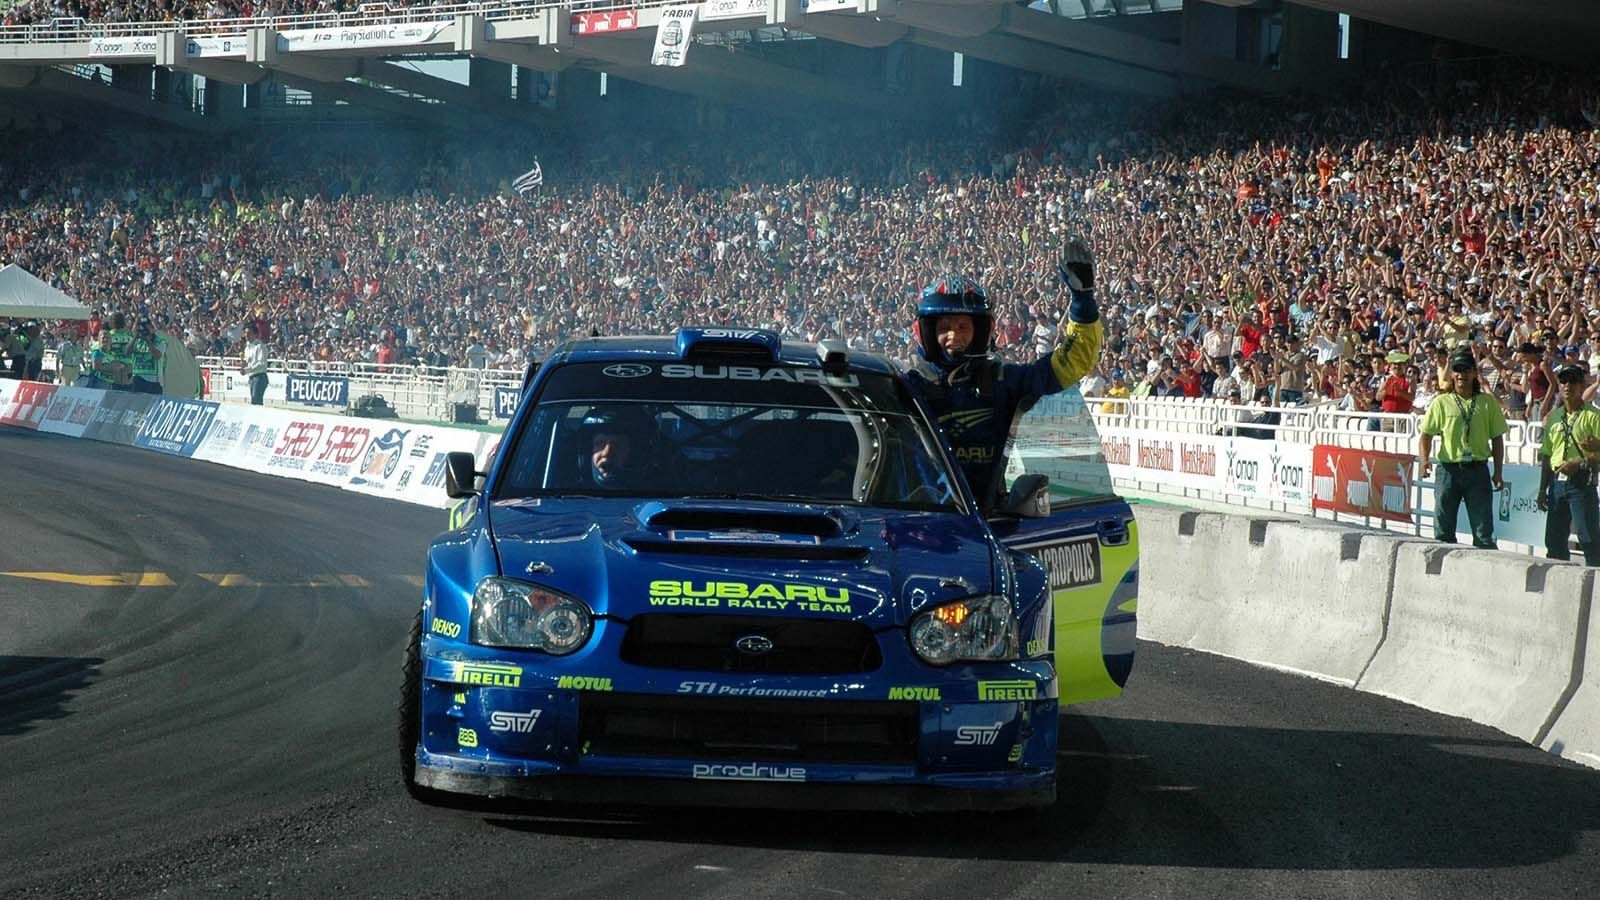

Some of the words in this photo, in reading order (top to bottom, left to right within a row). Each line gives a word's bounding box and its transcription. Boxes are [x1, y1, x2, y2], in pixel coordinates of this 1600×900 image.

[662, 9, 694, 18] FABIA
[661, 364, 860, 388] SUBARU
[290, 379, 344, 402] PEUGEOT
[649, 580, 850, 604] SUBARU
[649, 597, 719, 607] WORLD
[728, 599, 788, 610] RALLY
[799, 602, 852, 614] TEAM
[431, 617, 461, 638] DENSO
[454, 664, 523, 688] PIRELLI
[557, 675, 613, 691] MOTUL
[677, 681, 717, 694] STI
[718, 684, 828, 698] Performance
[888, 687, 942, 701] MOTUL
[977, 680, 1037, 701] PIRELLI
[693, 762, 807, 782] prodrive
